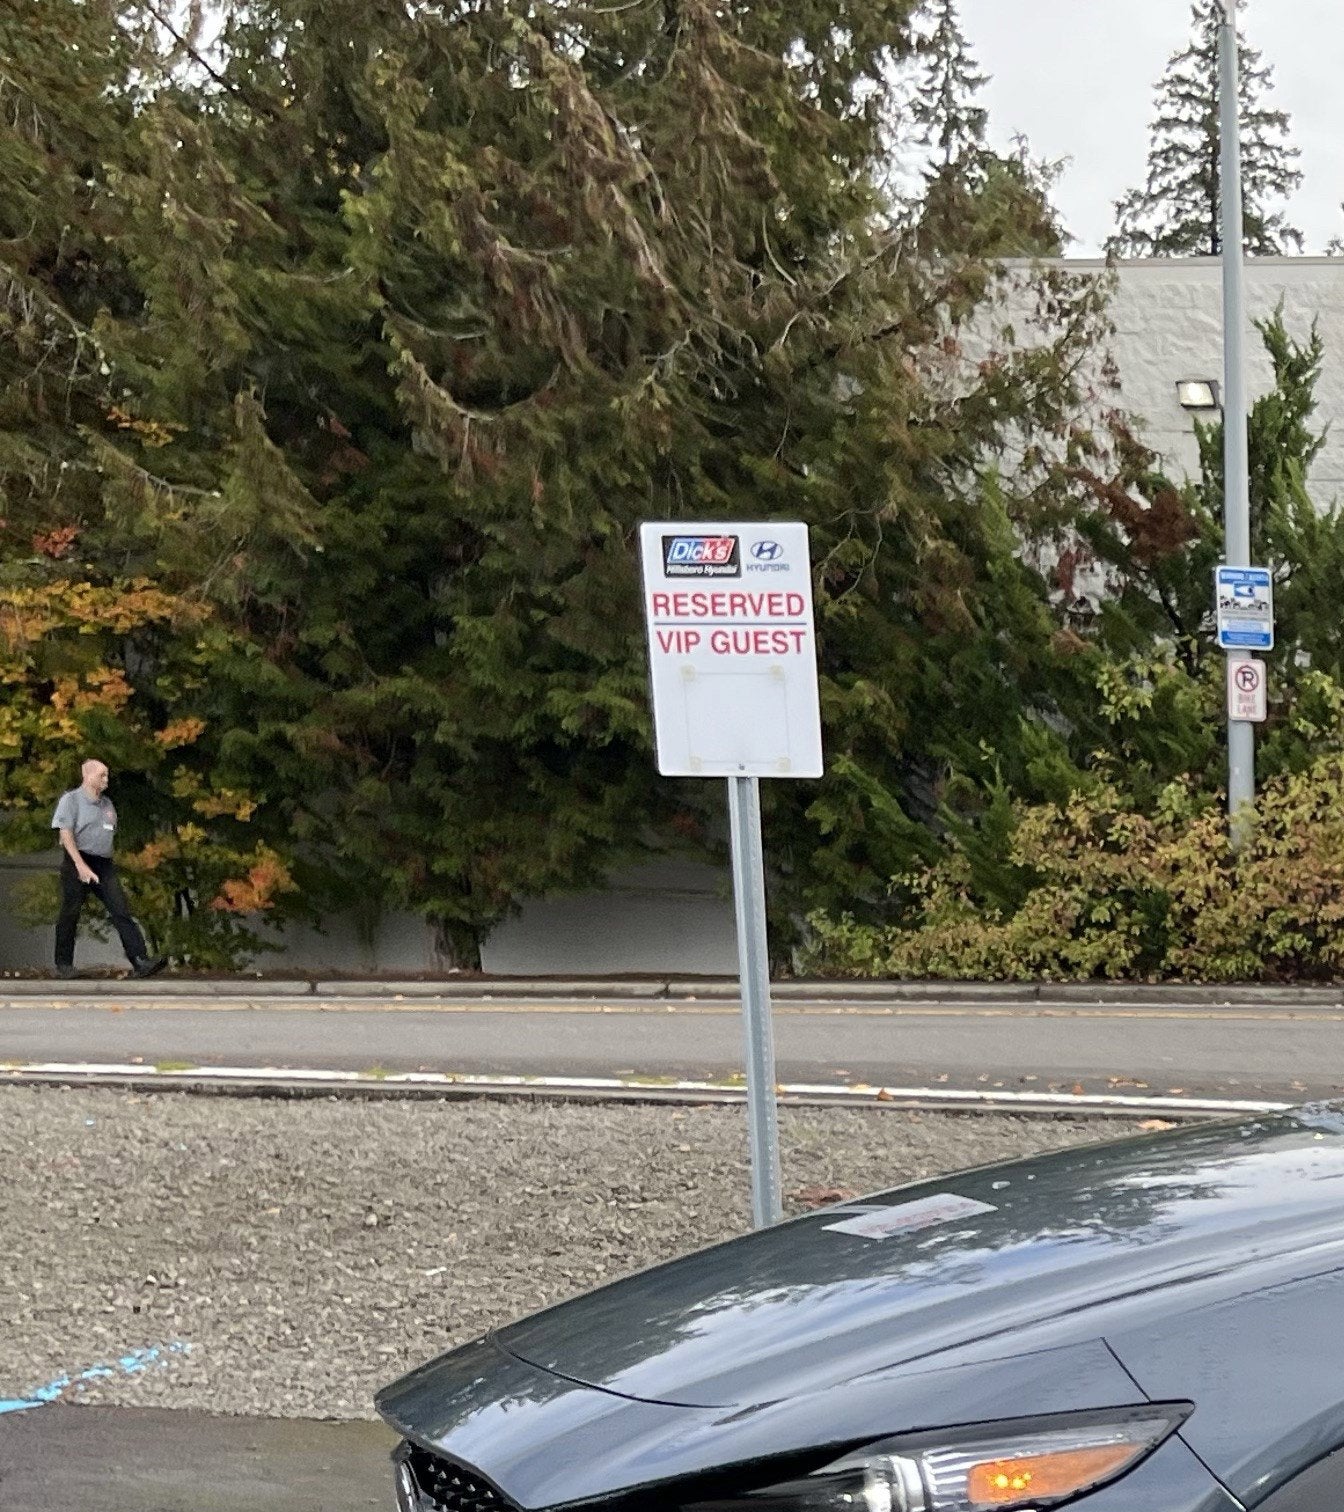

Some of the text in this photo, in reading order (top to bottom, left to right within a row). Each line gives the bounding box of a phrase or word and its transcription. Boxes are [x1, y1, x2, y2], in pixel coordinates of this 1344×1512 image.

[652, 592, 806, 618] RESERVED
[657, 629, 806, 656] VIP GUEST
